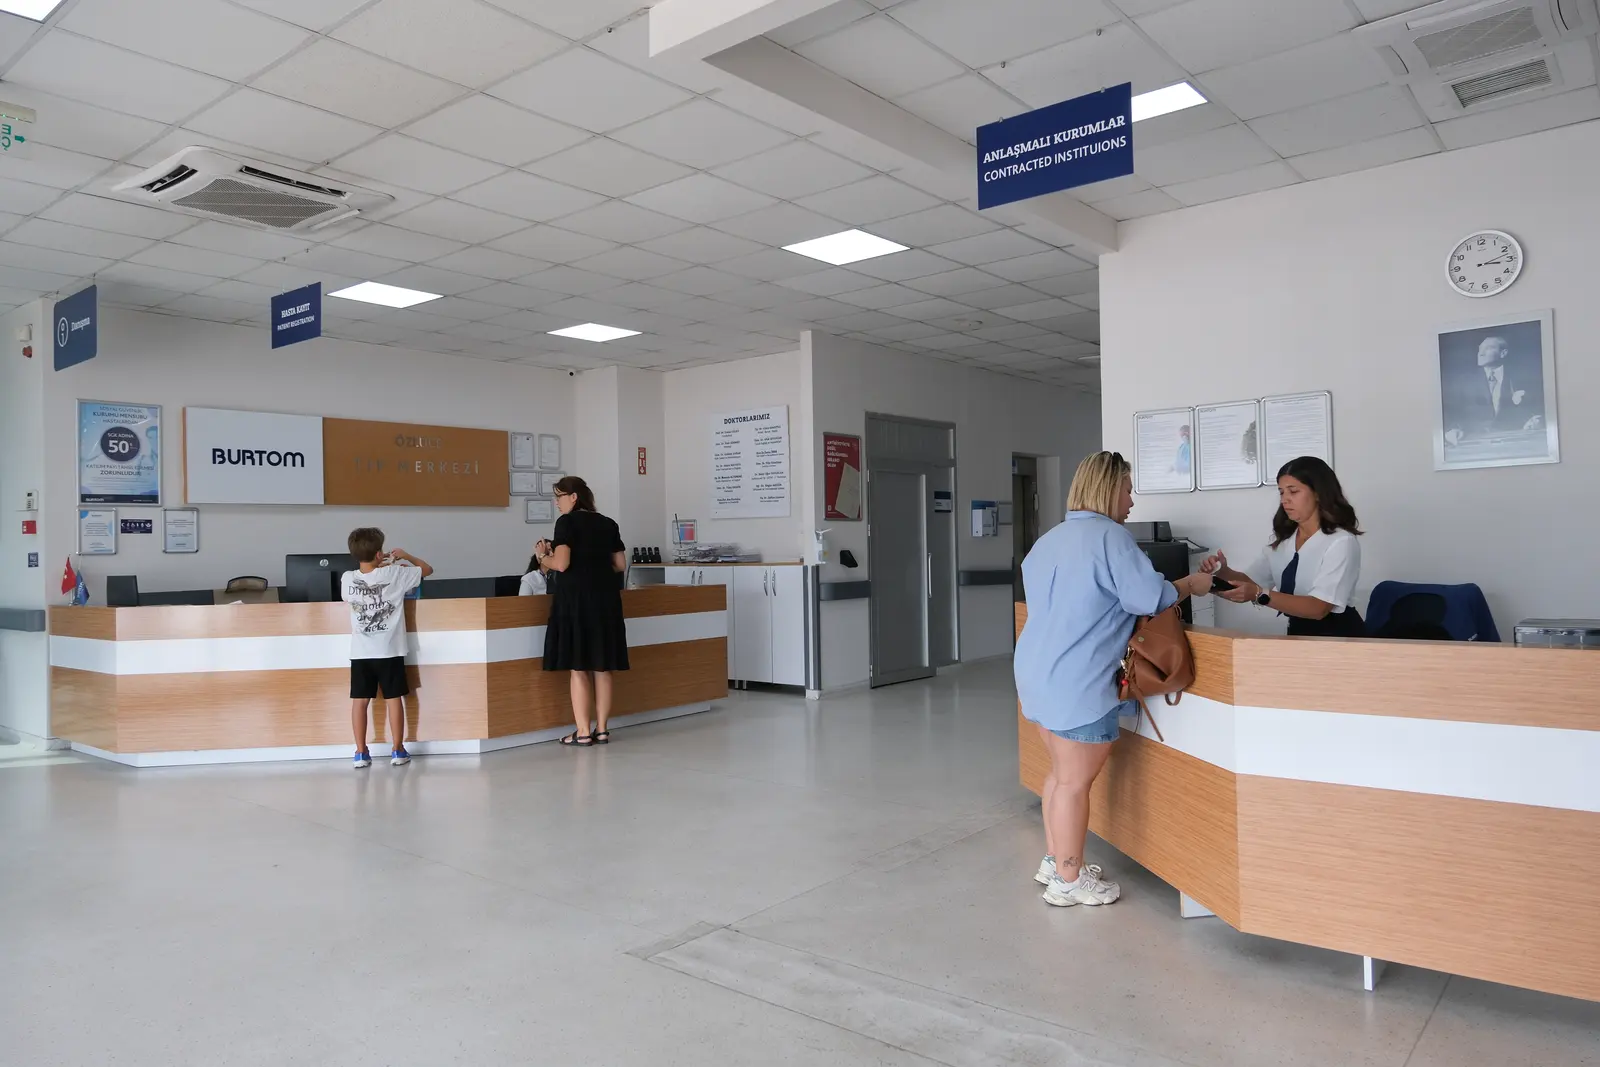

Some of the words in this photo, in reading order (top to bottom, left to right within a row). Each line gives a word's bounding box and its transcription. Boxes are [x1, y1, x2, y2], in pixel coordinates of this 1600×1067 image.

[983, 135, 1051, 164] ANLAŞMALI
[1053, 115, 1126, 144] KURUMLAR
[984, 156, 1052, 182] CONTRACTED
[1054, 135, 1127, 164] INSTITUIONS
[1477, 238, 1486, 246] 12
[1501, 245, 1508, 253] 2
[1481, 282, 1489, 290] 6
[281, 307, 296, 318] HASTA
[724, 413, 770, 424] DOKTORLARIMIZ
[212, 448, 304, 467] BURTOM
